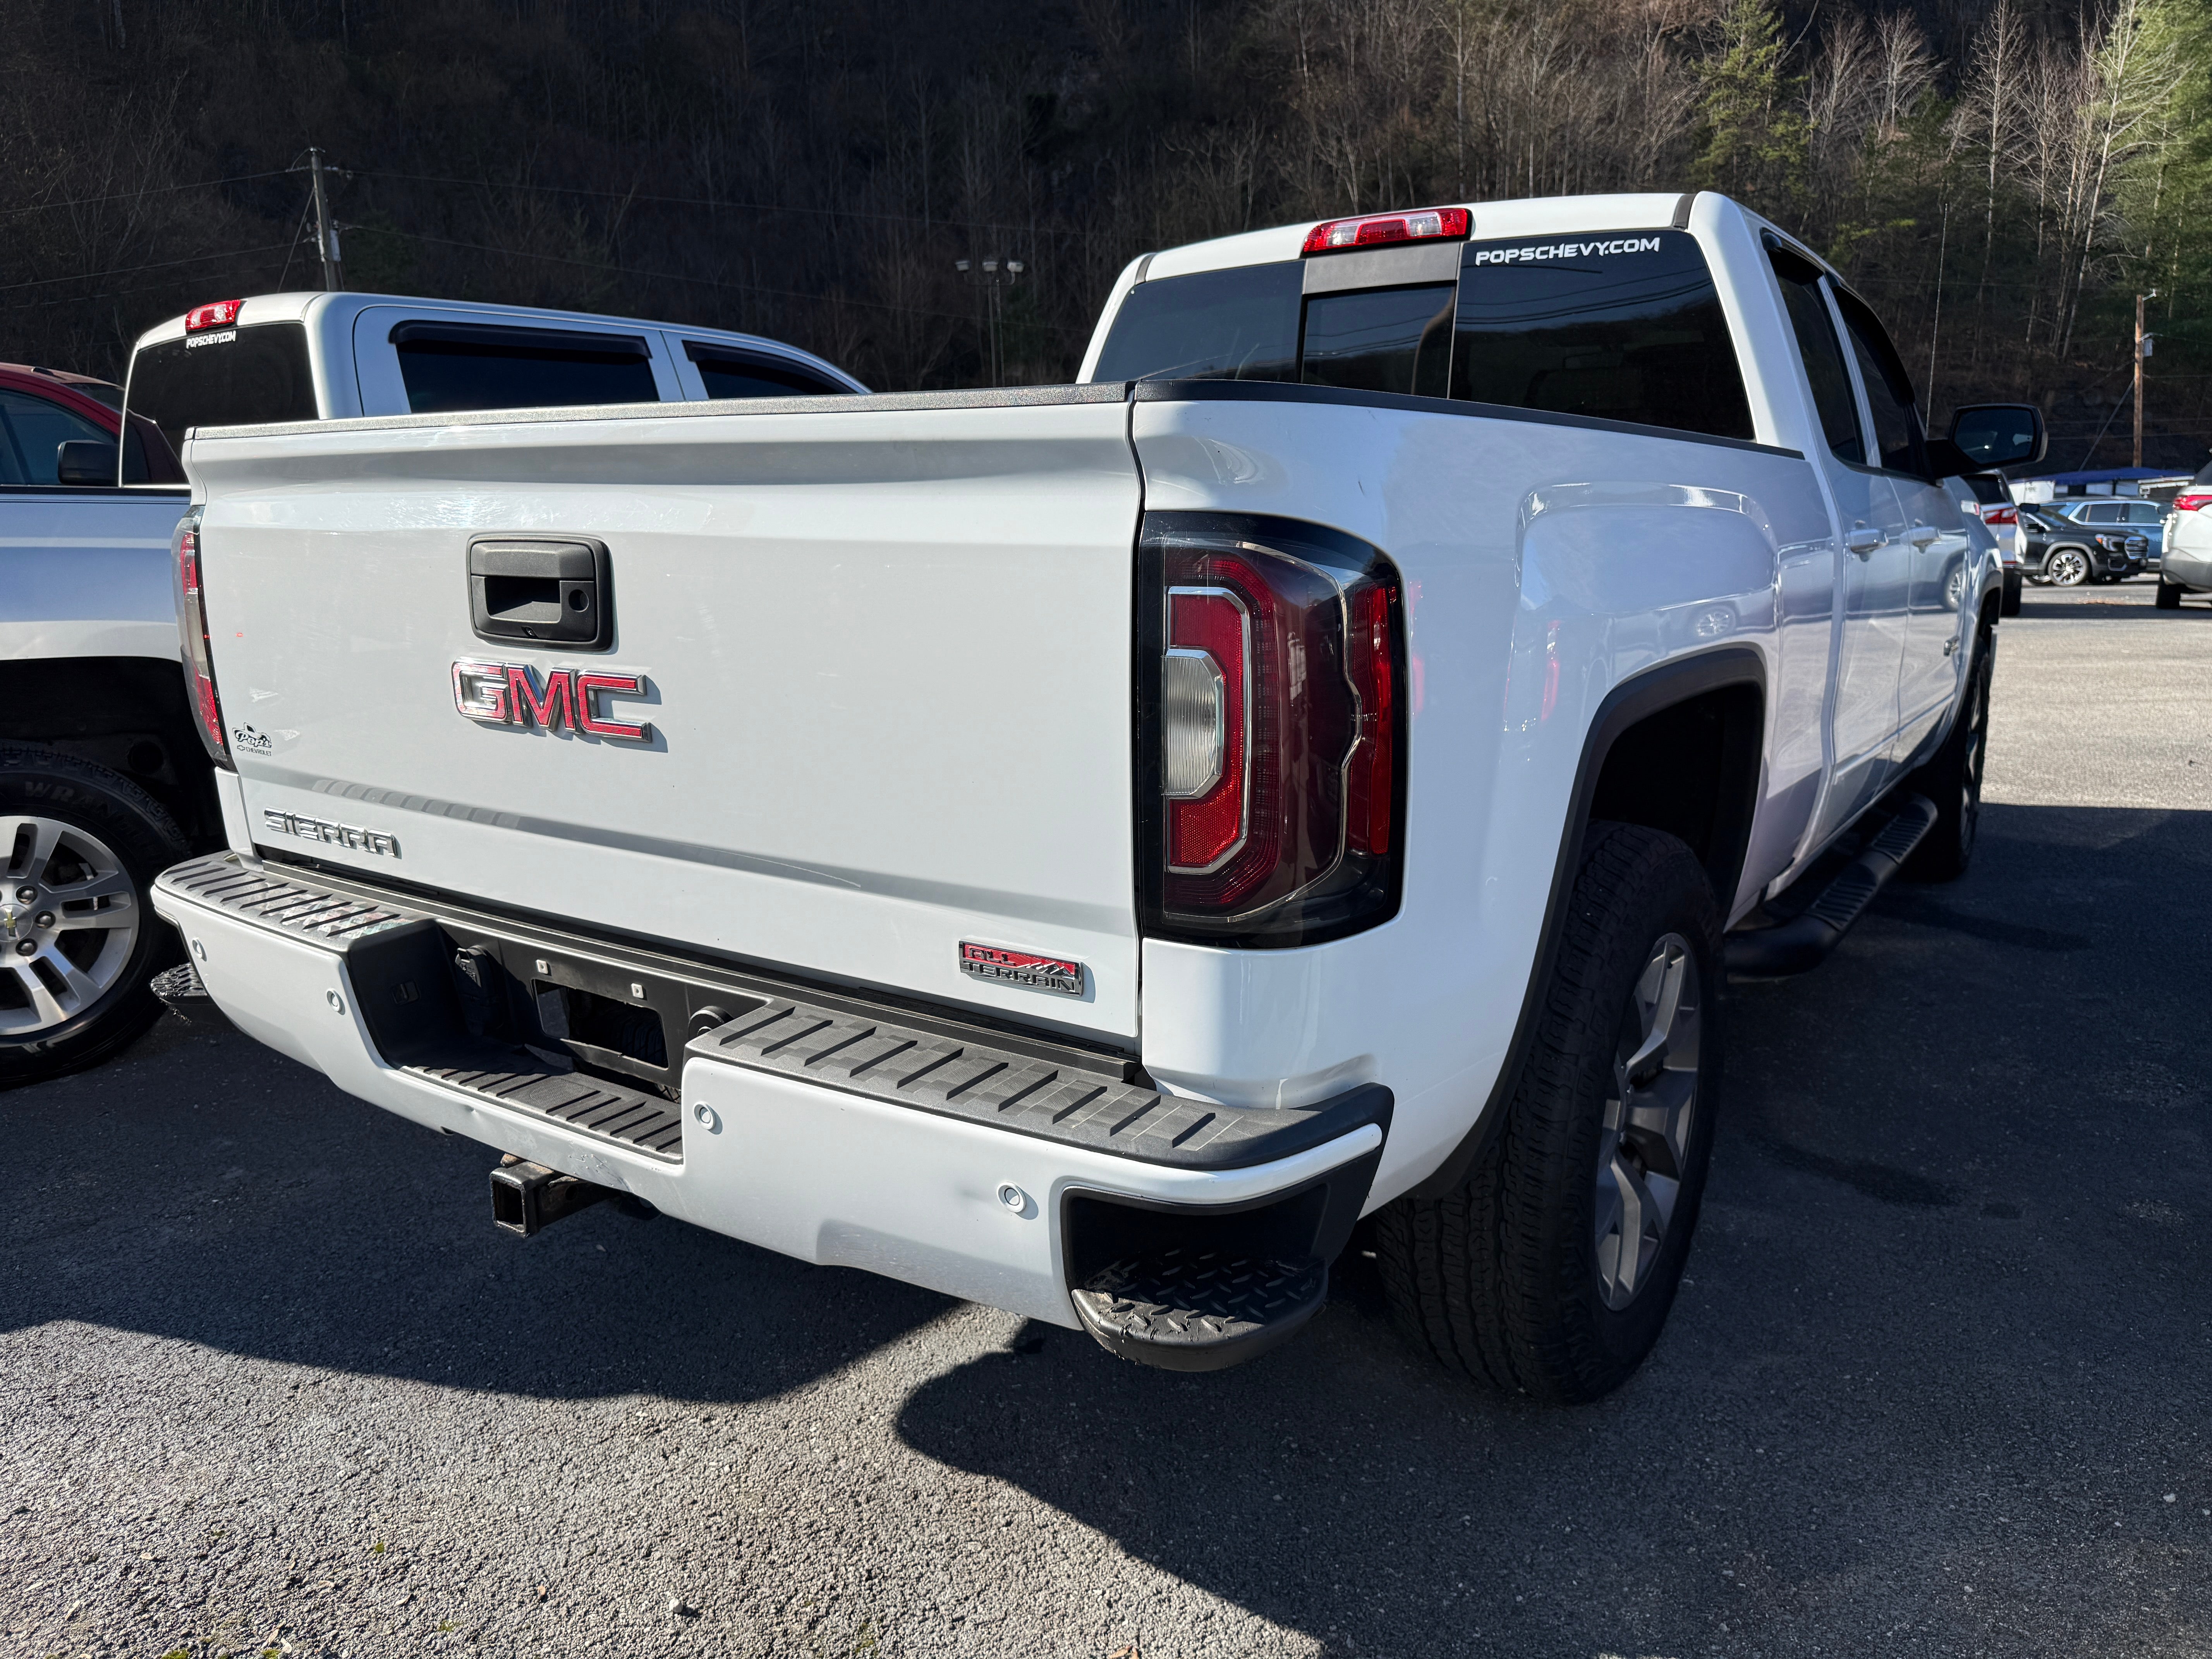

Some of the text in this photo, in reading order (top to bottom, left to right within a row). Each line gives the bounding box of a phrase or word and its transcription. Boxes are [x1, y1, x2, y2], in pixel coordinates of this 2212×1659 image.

[1475, 237, 1660, 266] POPSCHEVY.COM
[451, 658, 652, 742] GMC
[264, 807, 400, 858] SIERRA
[969, 948, 1016, 966] ALL
[963, 962, 1076, 992] TERRAIN
